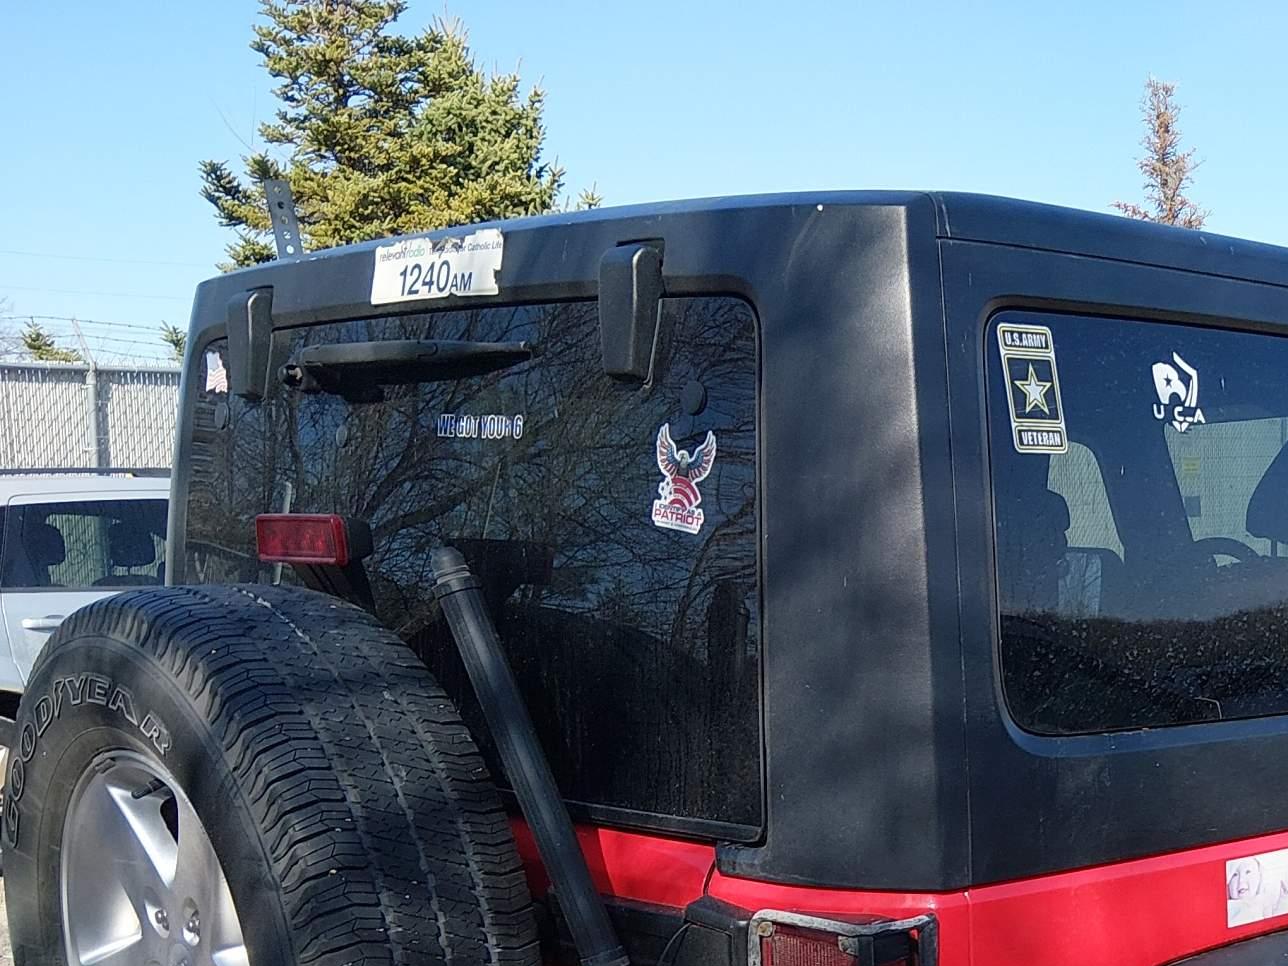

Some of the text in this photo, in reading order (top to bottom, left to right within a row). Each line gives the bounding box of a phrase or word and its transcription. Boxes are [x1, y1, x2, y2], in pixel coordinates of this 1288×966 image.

[437, 414, 455, 437] WE
[456, 414, 480, 438] GOT
[513, 414, 523, 439] 6
[1021, 431, 1062, 446] VETERAN
[654, 508, 702, 526] PATRIOT
[6, 672, 172, 848] GOODYEAR
